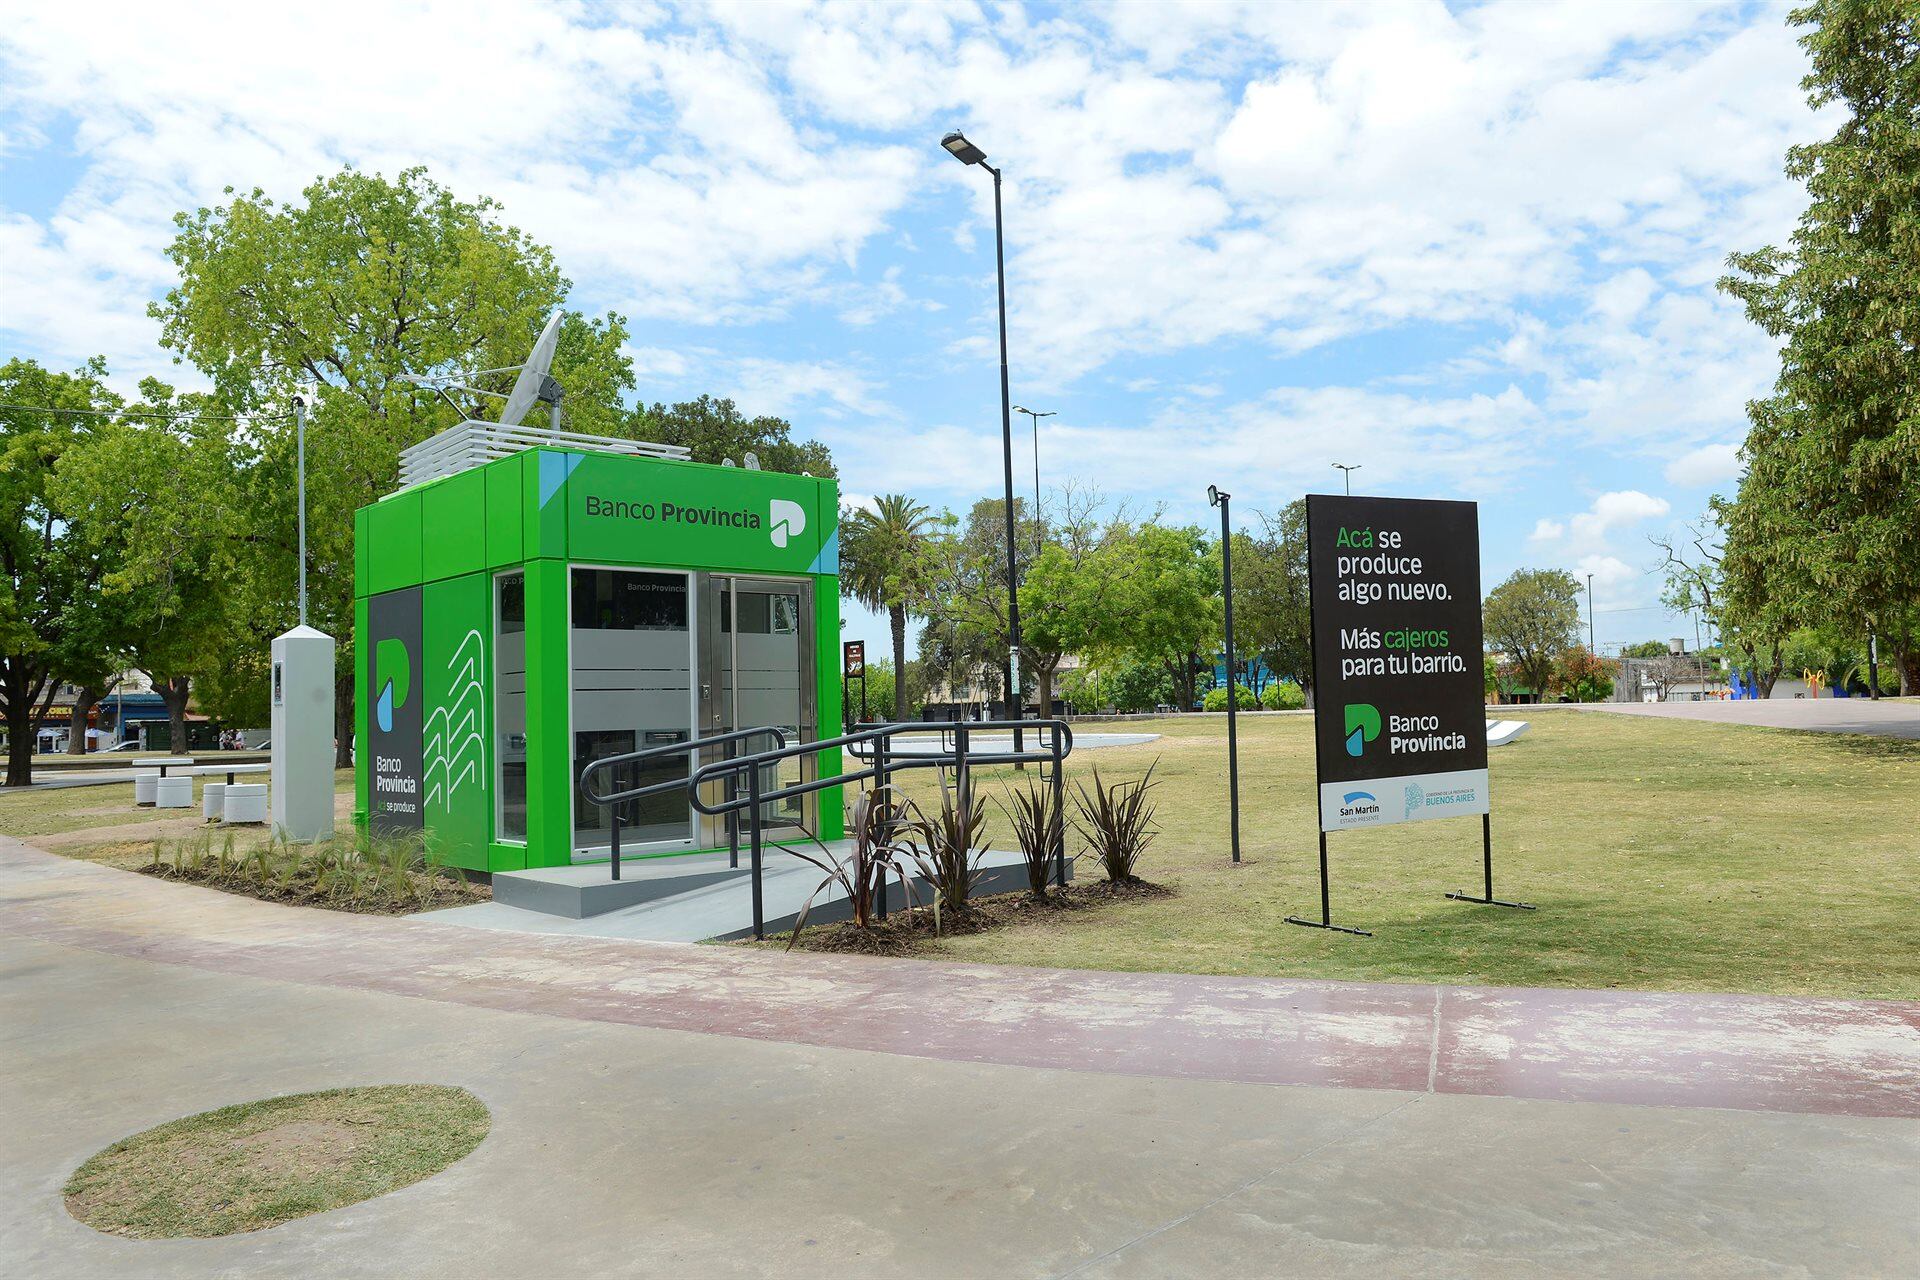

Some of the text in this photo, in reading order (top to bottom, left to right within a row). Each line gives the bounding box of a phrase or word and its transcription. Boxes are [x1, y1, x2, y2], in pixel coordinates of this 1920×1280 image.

[586, 495, 761, 529] Banco Provincia
[1336, 526, 1402, 549] Acá se
[1337, 552, 1422, 578] produce
[627, 583, 687, 593] Banco Provincia
[1338, 578, 1452, 605] algo nuevo.
[1340, 626, 1449, 652] Más cajeros
[1342, 651, 1467, 681] para tu barrio.
[1389, 715, 1439, 733] Banco
[1390, 732, 1466, 754] Provincia
[377, 755, 401, 772] Banco
[377, 775, 416, 793] Provincia
[386, 802, 393, 811] se
[393, 802, 416, 813] produce
[1425, 793, 1475, 806] BUENOS AIRES
[1340, 807, 1354, 817] San
[1340, 814, 1379, 825] ESTADO PRESENTE
